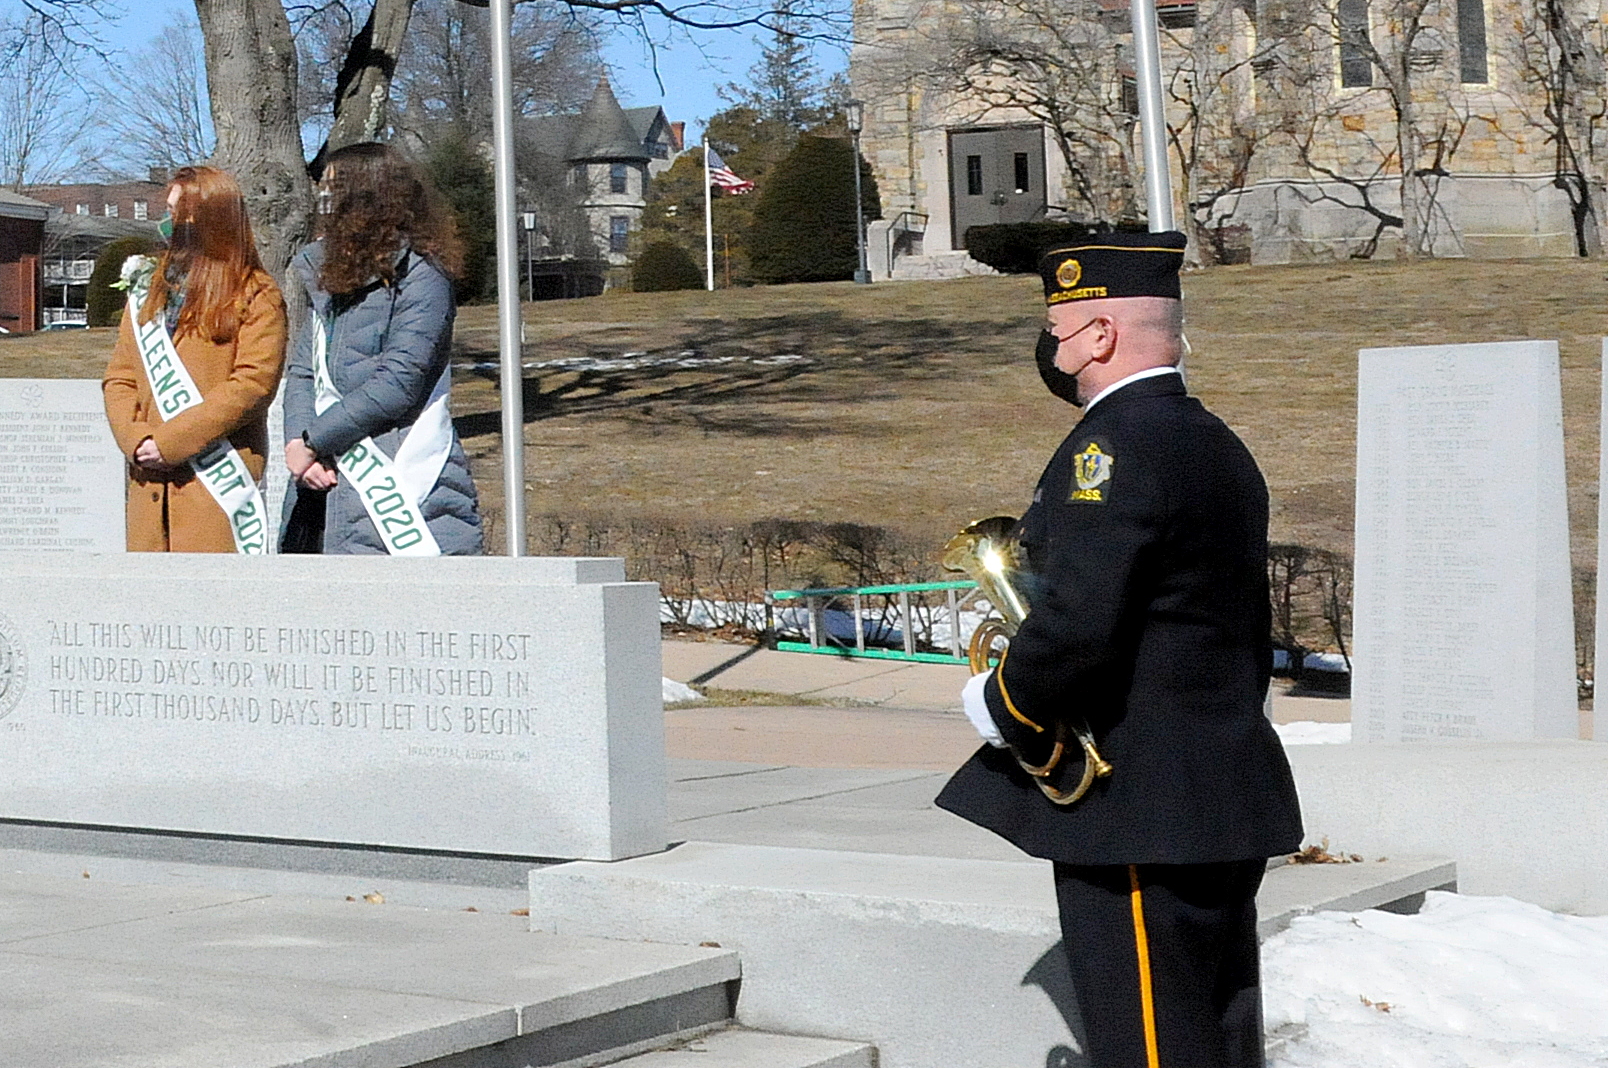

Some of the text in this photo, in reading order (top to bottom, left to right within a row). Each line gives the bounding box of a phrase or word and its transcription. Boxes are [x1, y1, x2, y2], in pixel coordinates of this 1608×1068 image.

[30, 412, 59, 421] AWARD
[196, 442, 265, 554] URT 202
[365, 476, 423, 550] 2020
[89, 622, 132, 649] THIS
[140, 624, 188, 650] WILL
[195, 625, 234, 652] NOT
[244, 627, 268, 653] BE
[278, 628, 375, 656] FINISHED
[386, 631, 407, 657] IN
[416, 631, 459, 659] THE
[469, 633, 531, 661] FIRST
[50, 656, 530, 698] HUNDRED DAYS. NOR WILL IT BE FINISHED IN
[49, 689, 85, 715] THE
[93, 690, 145, 718] FIRST
[151, 693, 260, 724] THOUSAND
[271, 698, 325, 726] DAYS.
[332, 700, 372, 728] BUT
[382, 703, 416, 731] LET
[426, 705, 453, 732] US
